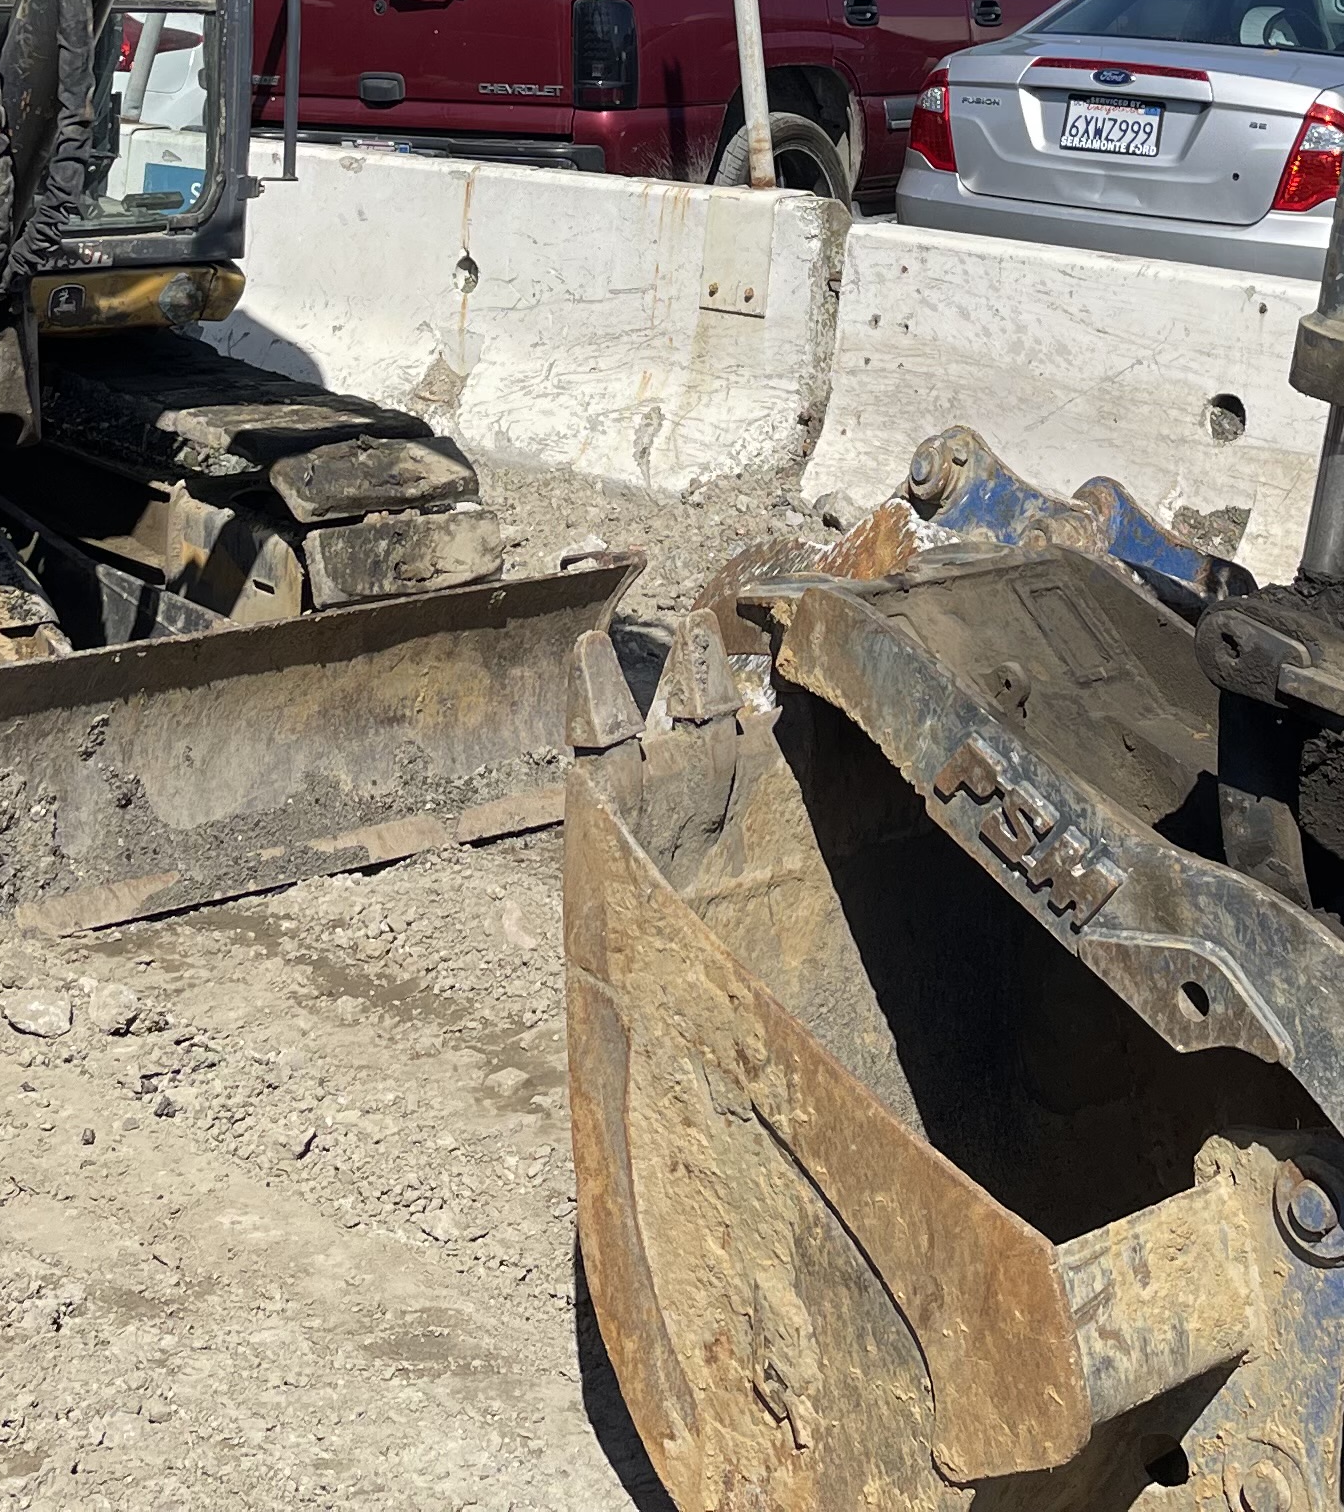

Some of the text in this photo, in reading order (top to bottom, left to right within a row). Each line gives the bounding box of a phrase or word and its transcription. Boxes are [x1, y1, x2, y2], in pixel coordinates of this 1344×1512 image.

[478, 82, 564, 97] CHEVROLET
[961, 96, 1001, 106] FUSION
[1068, 115, 1154, 146] 6XWZ999
[1060, 136, 1157, 157] SERRAMONTE FORD
